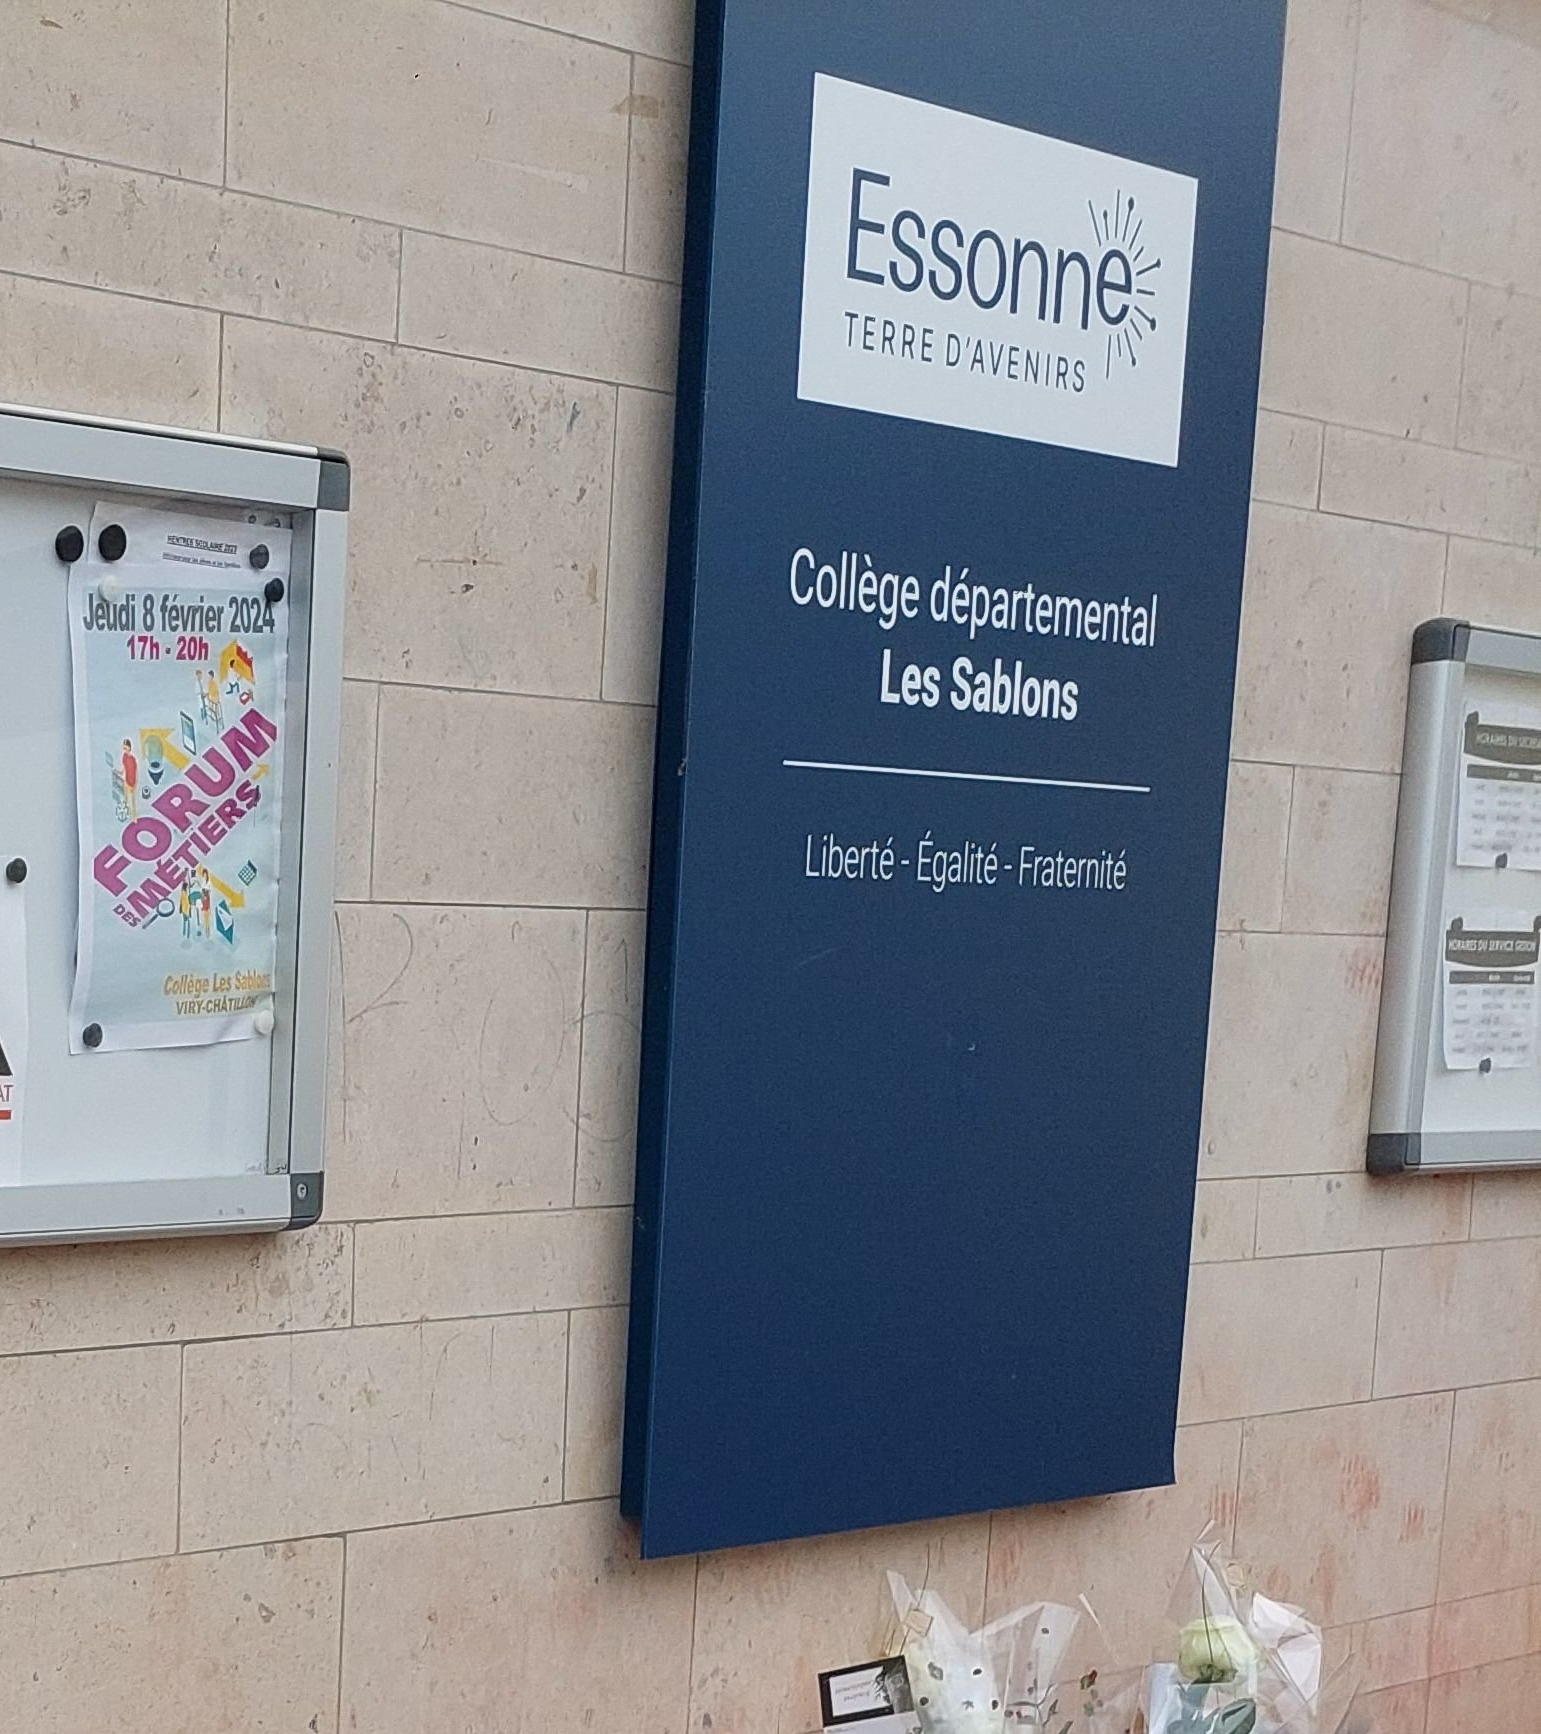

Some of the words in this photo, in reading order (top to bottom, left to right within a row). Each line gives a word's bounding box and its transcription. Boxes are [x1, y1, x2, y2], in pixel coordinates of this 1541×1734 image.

[847, 167, 1132, 330] Essonne
[844, 311, 934, 363] TERRE
[945, 333, 1086, 393] D'AVENIRS
[83, 592, 136, 632] Jeudi
[142, 593, 155, 632] 8
[160, 593, 224, 633] février
[228, 596, 275, 634] 2024
[790, 547, 920, 631] Collège
[930, 564, 1158, 647] départemental
[127, 634, 160, 660] 17h
[176, 635, 209, 661] 20h
[880, 648, 941, 708] Les
[950, 656, 1079, 721] Sablons
[93, 708, 277, 897] FORUM
[805, 832, 895, 881] Liberté
[917, 830, 998, 893] Égalité
[1018, 846, 1127, 890] Fraternité
[113, 904, 141, 927] DES
[164, 973, 210, 998] Collège
[213, 972, 232, 993] Les
